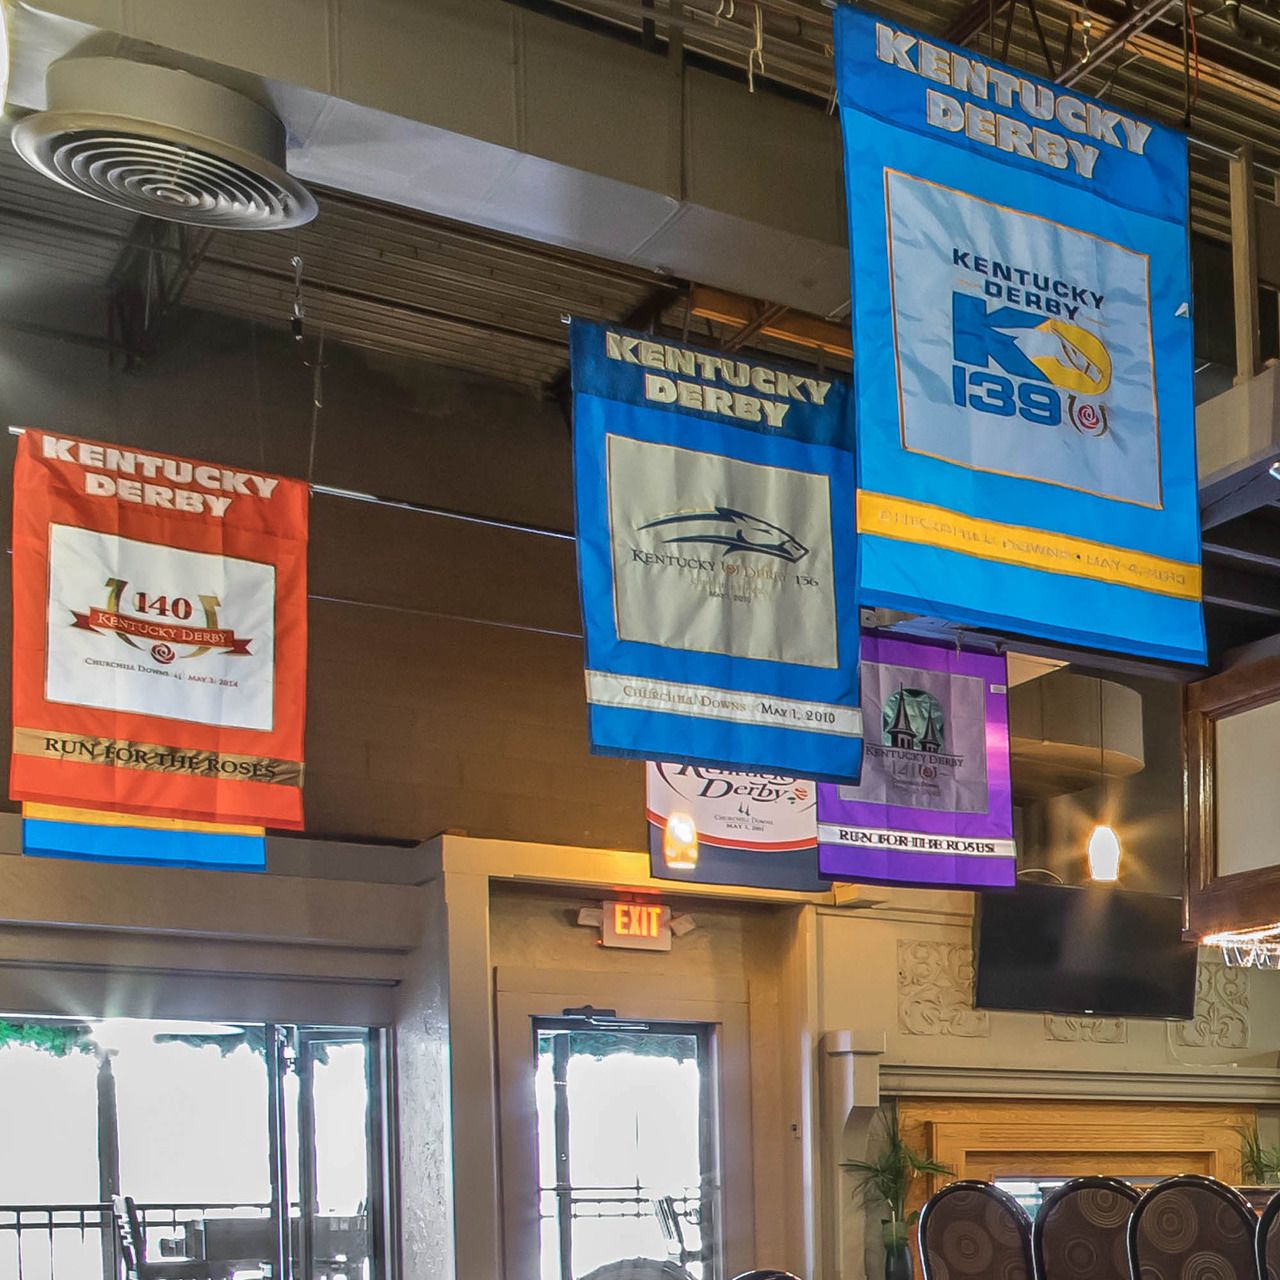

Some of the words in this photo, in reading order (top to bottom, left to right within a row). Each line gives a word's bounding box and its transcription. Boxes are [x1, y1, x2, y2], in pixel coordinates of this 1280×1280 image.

[875, 22, 1152, 155] KENTUCKY
[926, 88, 1099, 178] DERBY
[953, 248, 1104, 310] KENTUCKY
[984, 279, 1079, 321] DERBY
[606, 331, 831, 405] KENTUCKY
[645, 373, 789, 427] DERBY
[953, 365, 1062, 426] 139
[42, 435, 278, 499] KENTUCKY
[85, 472, 232, 517] DERBY
[631, 548, 716, 572] KENTUCKY
[135, 592, 193, 620] 140
[97, 613, 177, 638] KENTUCKY
[181, 630, 227, 645] DERBY
[623, 685, 695, 705] CHURCHILL
[700, 695, 747, 712] DOWNS
[760, 702, 787, 718] MAY
[805, 711, 836, 723] 2010
[43, 737, 96, 757] RUN
[104, 745, 150, 764] FOR
[157, 751, 201, 770] THE
[205, 754, 277, 779] ROSES
[865, 746, 927, 761] KENTUCKY
[929, 755, 964, 767] DERBY
[697, 778, 789, 803] Derby
[615, 903, 661, 937] EXIT
